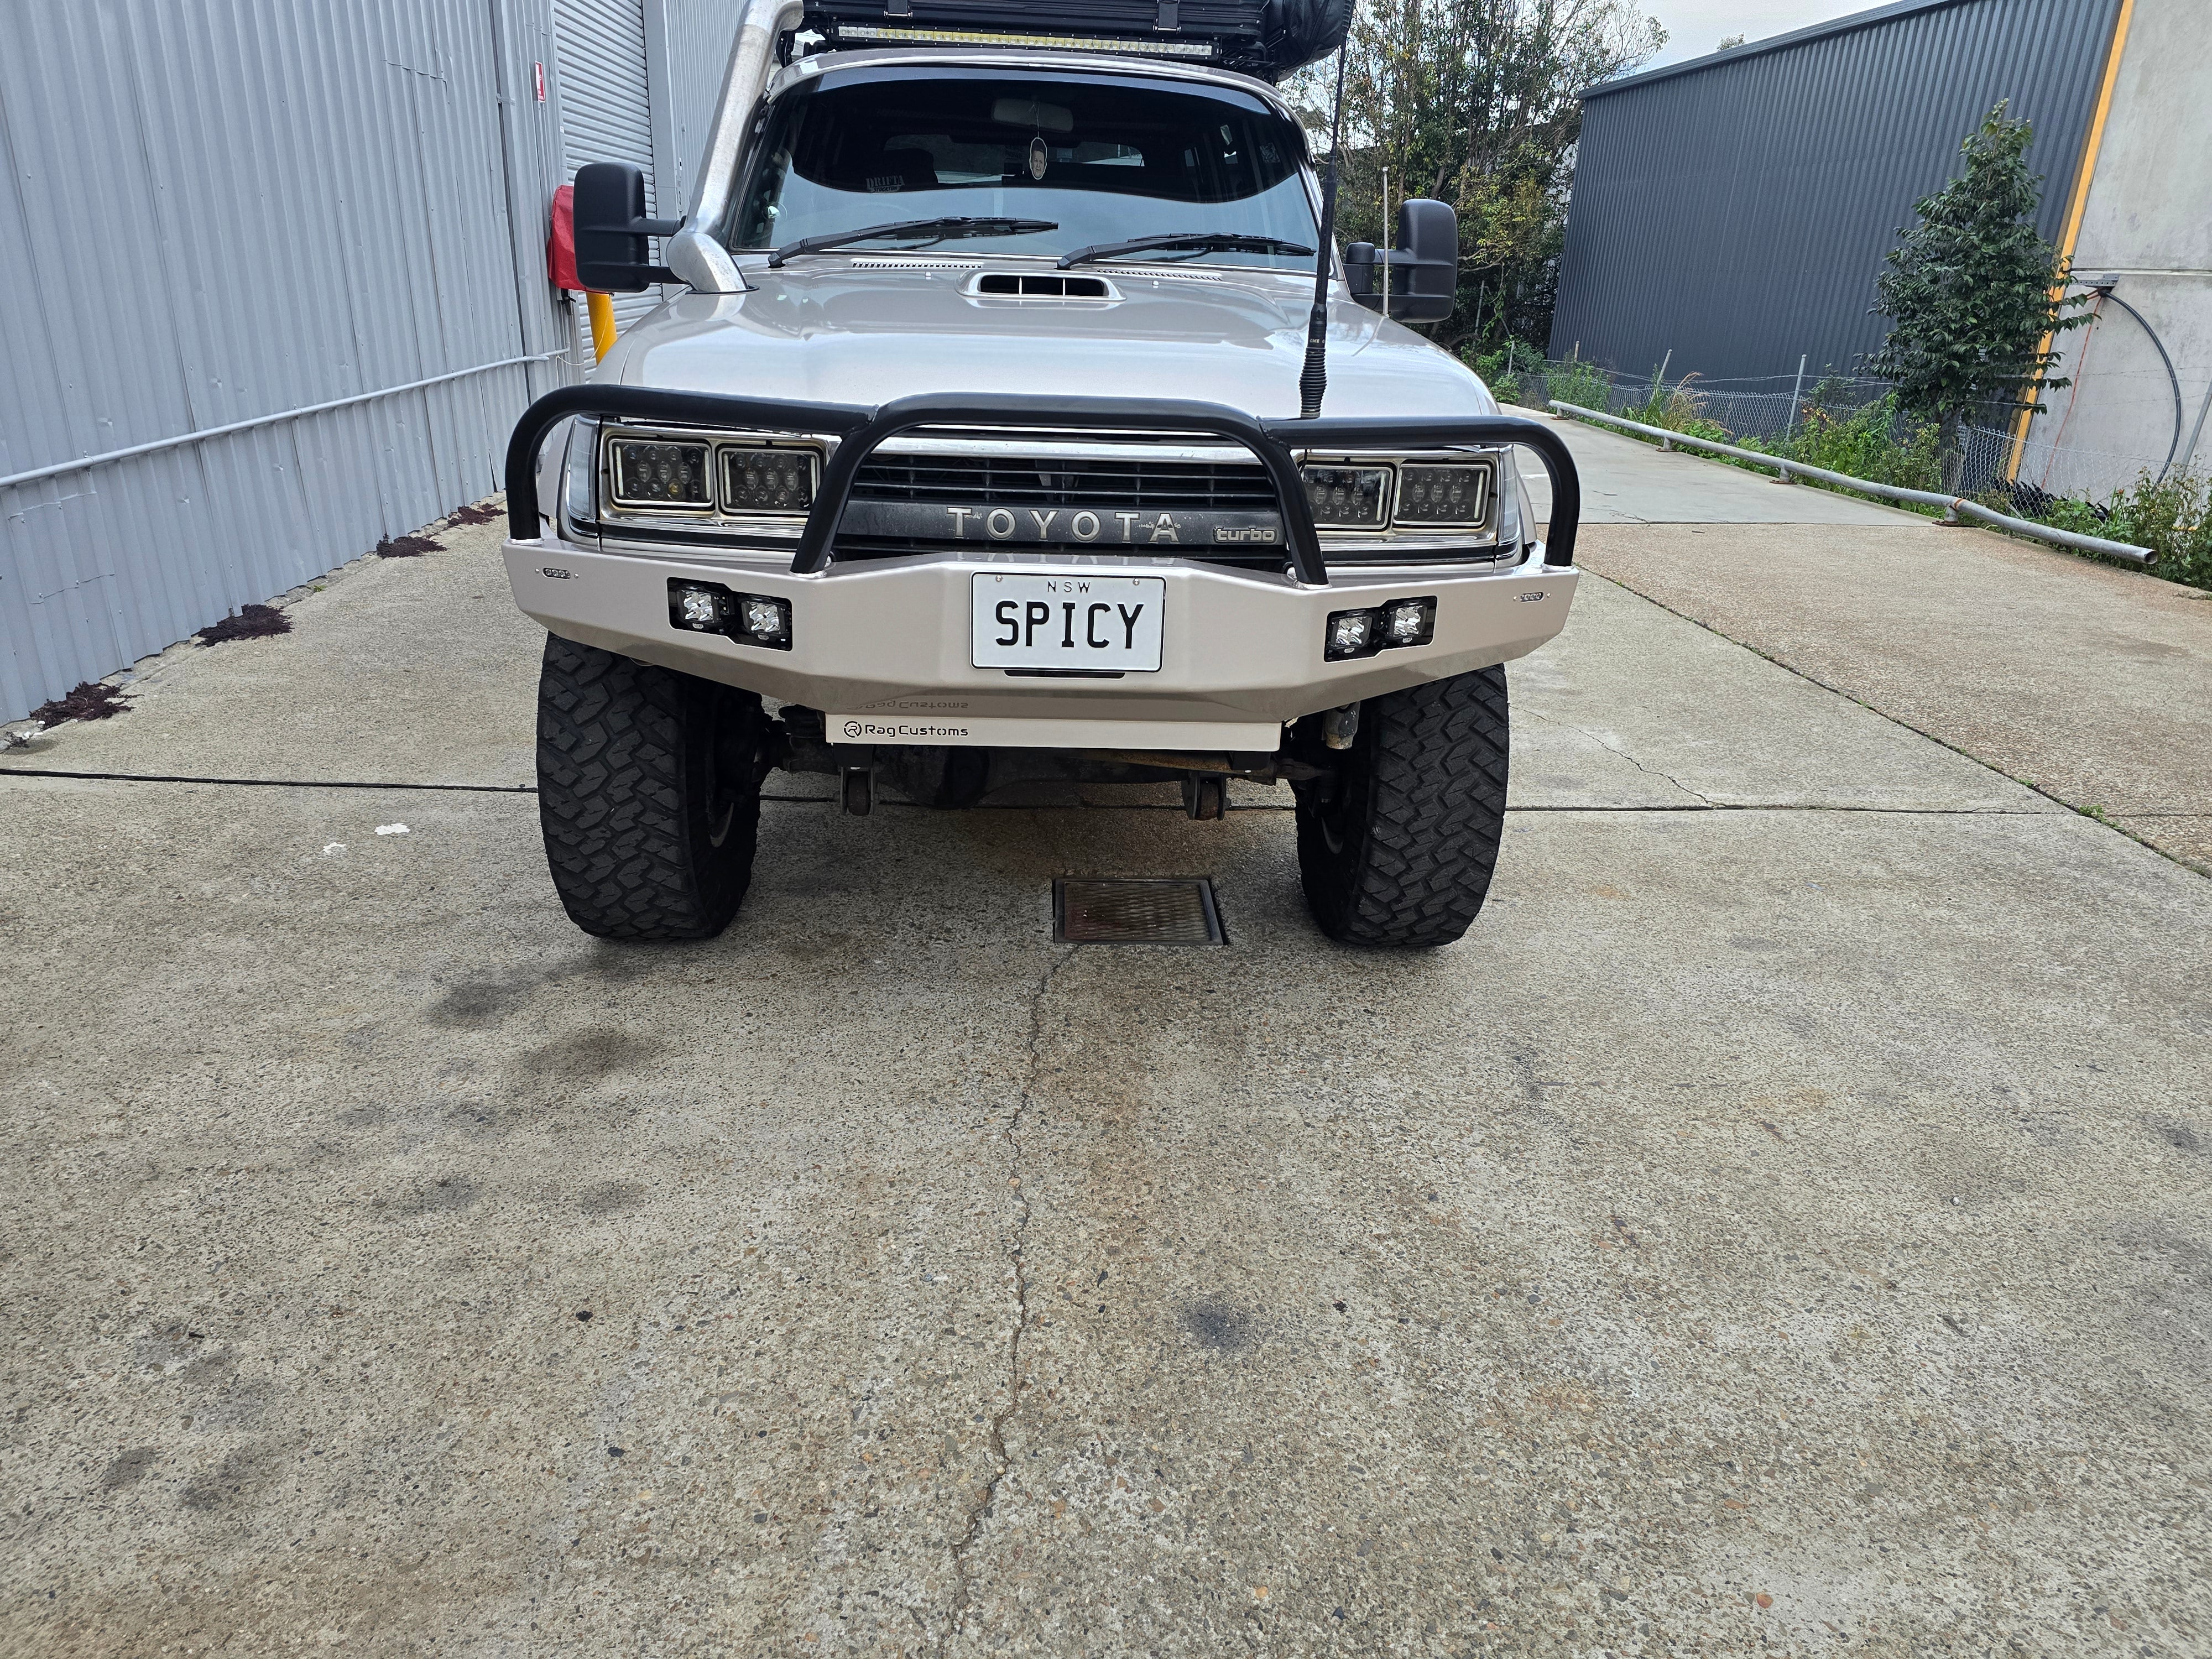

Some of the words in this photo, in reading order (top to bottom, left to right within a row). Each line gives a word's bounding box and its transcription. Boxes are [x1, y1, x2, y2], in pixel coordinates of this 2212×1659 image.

[865, 175, 905, 190] DRIFTA
[946, 507, 1181, 544] TOYOTA
[1216, 529, 1275, 541] turbo
[1047, 581, 1091, 593] NSW
[995, 600, 1145, 649] SPICY
[865, 724, 895, 738] Rag
[899, 725, 969, 737] Customs
